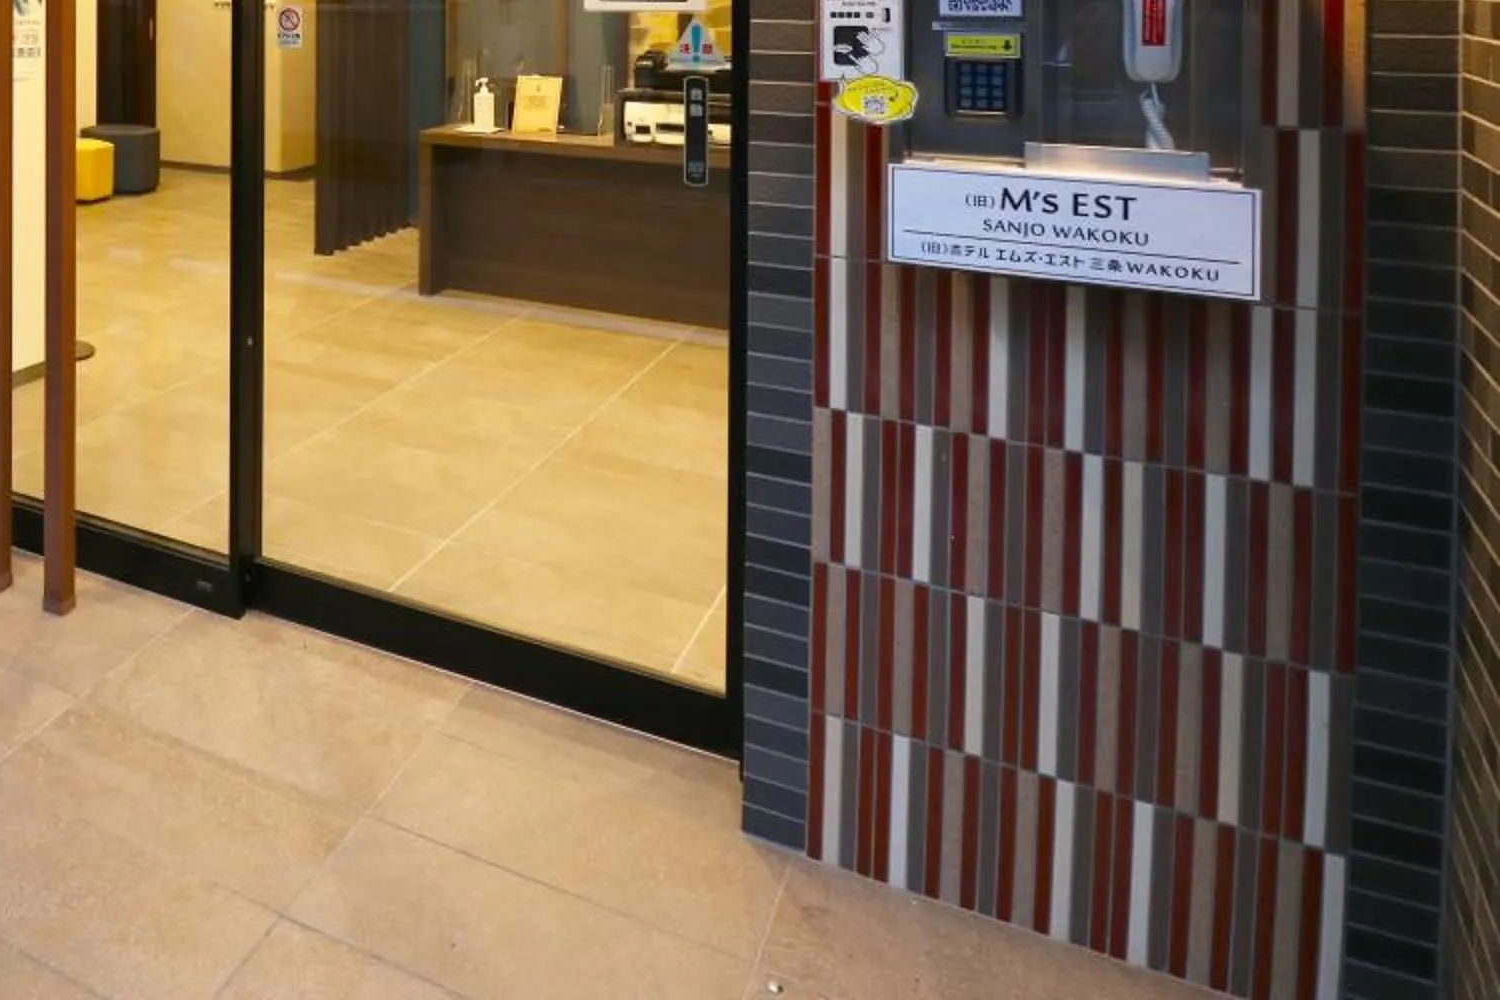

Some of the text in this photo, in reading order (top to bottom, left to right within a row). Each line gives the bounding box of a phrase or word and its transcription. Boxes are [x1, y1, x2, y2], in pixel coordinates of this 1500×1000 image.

[1000, 187, 1060, 215] M's
[1071, 193, 1138, 221] EST
[982, 219, 1150, 247] SANJO WAKOKU
[1127, 262, 1220, 282] WAKOKU
